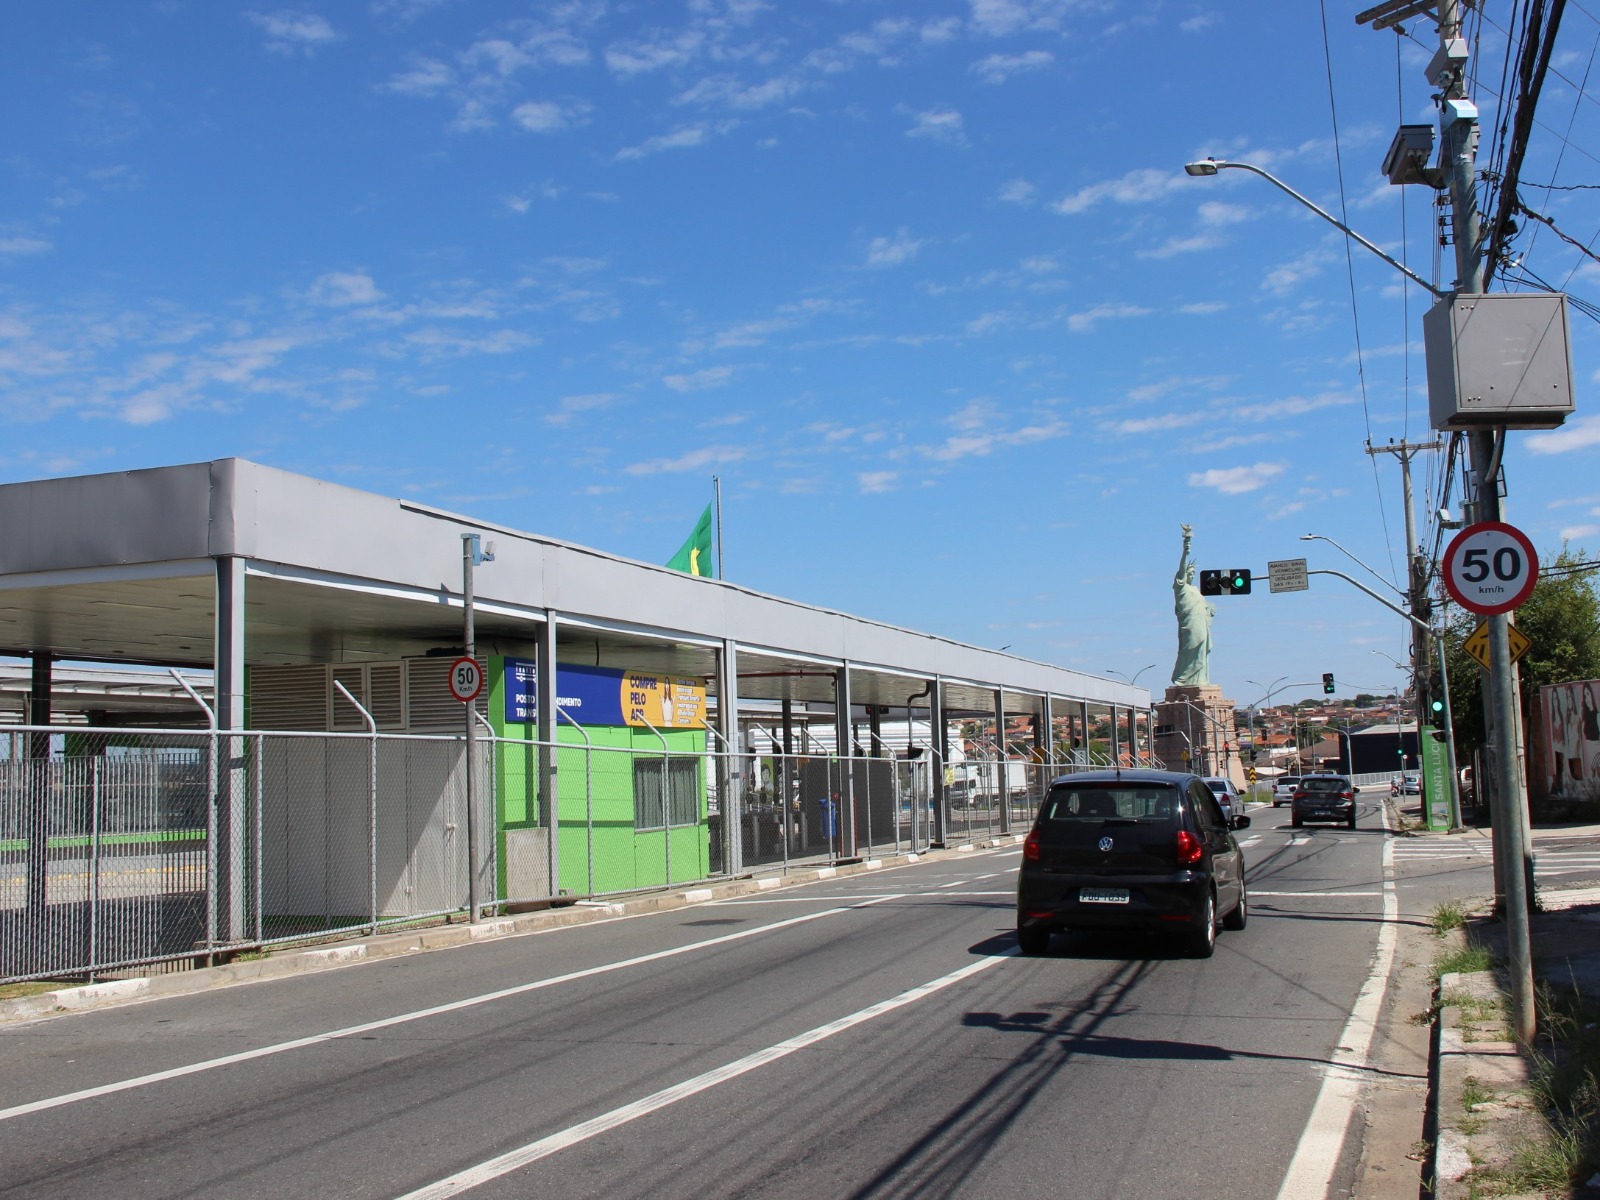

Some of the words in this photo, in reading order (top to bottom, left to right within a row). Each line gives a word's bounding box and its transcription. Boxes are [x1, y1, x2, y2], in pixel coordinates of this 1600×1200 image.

[1462, 547, 1521, 583] 50
[1478, 586, 1505, 594] km/h
[458, 667, 474, 685] 50
[630, 676, 657, 690] COMPRE
[515, 694, 536, 704] POSTO
[630, 692, 646, 705] PELO
[516, 708, 537, 718] TRANS
[630, 708, 645, 721] APP
[1433, 767, 1444, 800] SANTA
